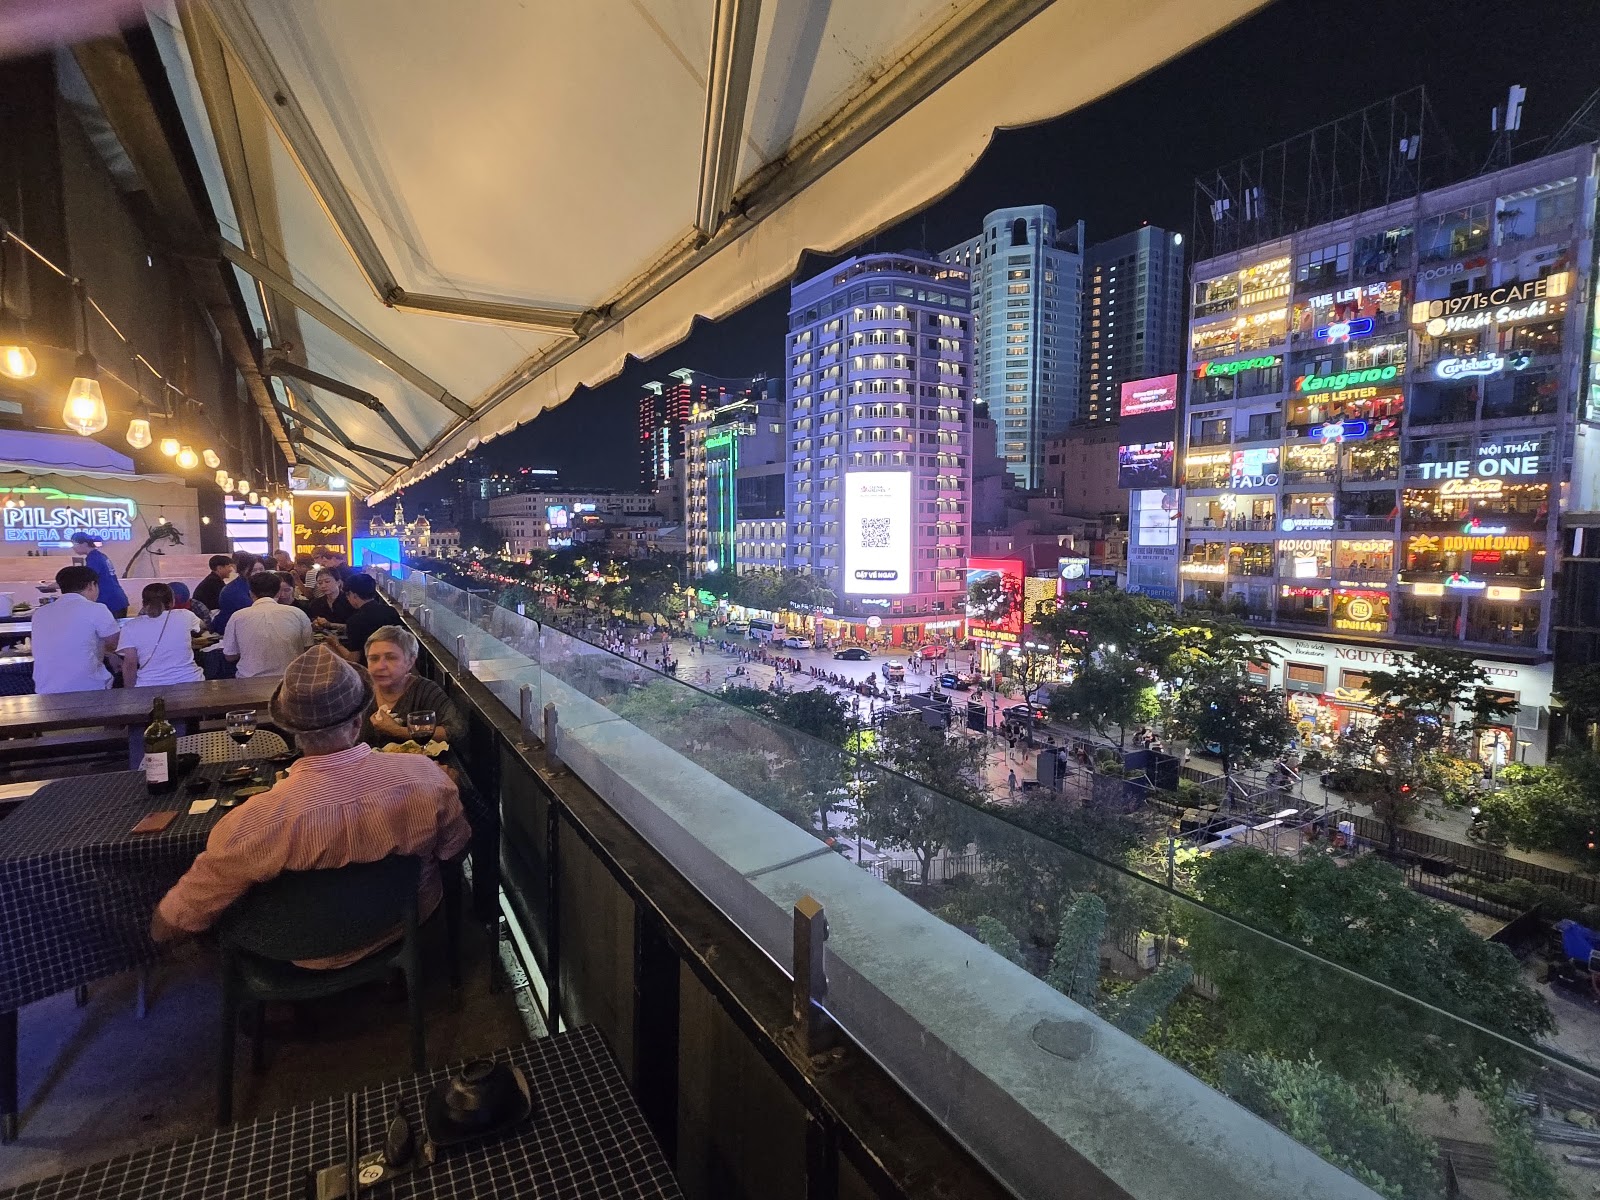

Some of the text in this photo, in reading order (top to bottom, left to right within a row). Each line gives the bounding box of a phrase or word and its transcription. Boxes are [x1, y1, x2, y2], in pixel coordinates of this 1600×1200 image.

[1308, 282, 1387, 308] THE LETER
[1443, 280, 1547, 314] 1971's CAFE
[1496, 301, 1547, 323] Sushi
[1198, 356, 1274, 377] Kangaroo
[1437, 353, 1504, 376] Carlsberg
[1296, 366, 1396, 391] Kangaroo
[1307, 387, 1377, 404] THE LETTER
[1419, 456, 1539, 479] THE ONE
[4, 508, 131, 527] PILSNER
[5, 528, 130, 541] EXTRA SOOTH
[1142, 588, 1175, 597] Expertise
